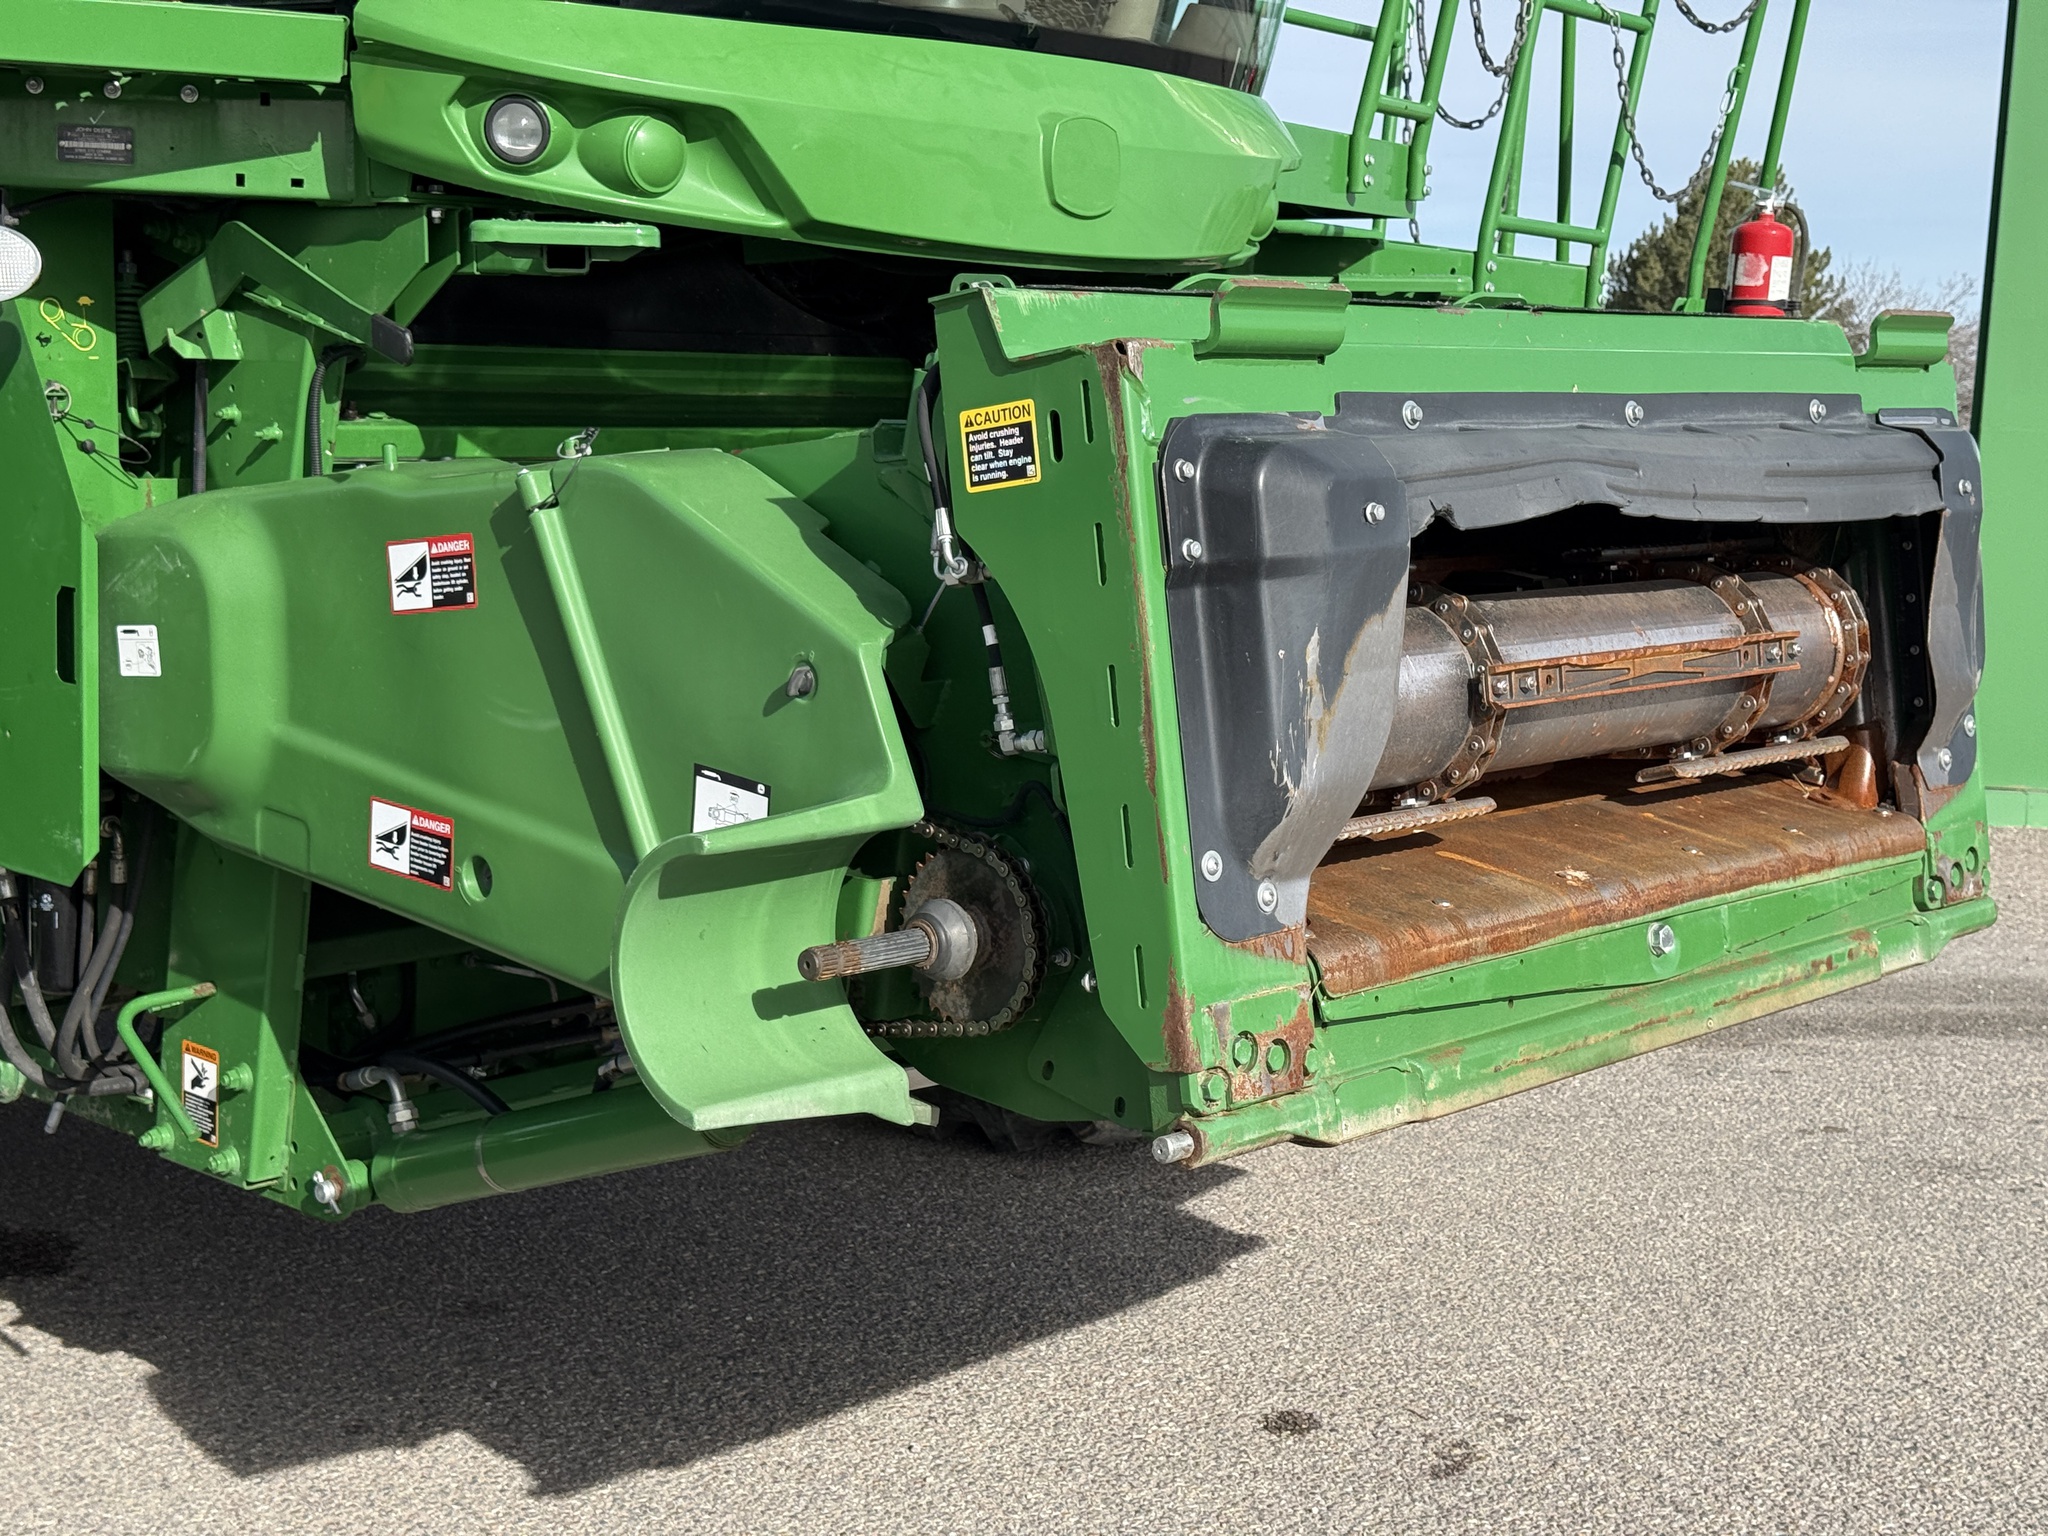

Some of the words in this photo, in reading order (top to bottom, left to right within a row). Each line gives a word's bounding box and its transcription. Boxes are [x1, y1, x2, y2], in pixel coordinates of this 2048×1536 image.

[974, 403, 1031, 426] CAUTION
[968, 431, 988, 442] Avoid
[989, 426, 1020, 438] crushing
[969, 441, 997, 453] injuries.
[999, 436, 1024, 446] Header
[970, 453, 983, 462] can
[998, 448, 1014, 458] Stay
[971, 463, 988, 472] clear
[989, 460, 1008, 469] when
[1008, 455, 1032, 466] engine
[972, 472, 979, 482] is
[980, 470, 1009, 482] running.
[438, 540, 470, 553] DANGER
[419, 816, 451, 834] DANGER
[191, 1046, 217, 1061] WARNING
